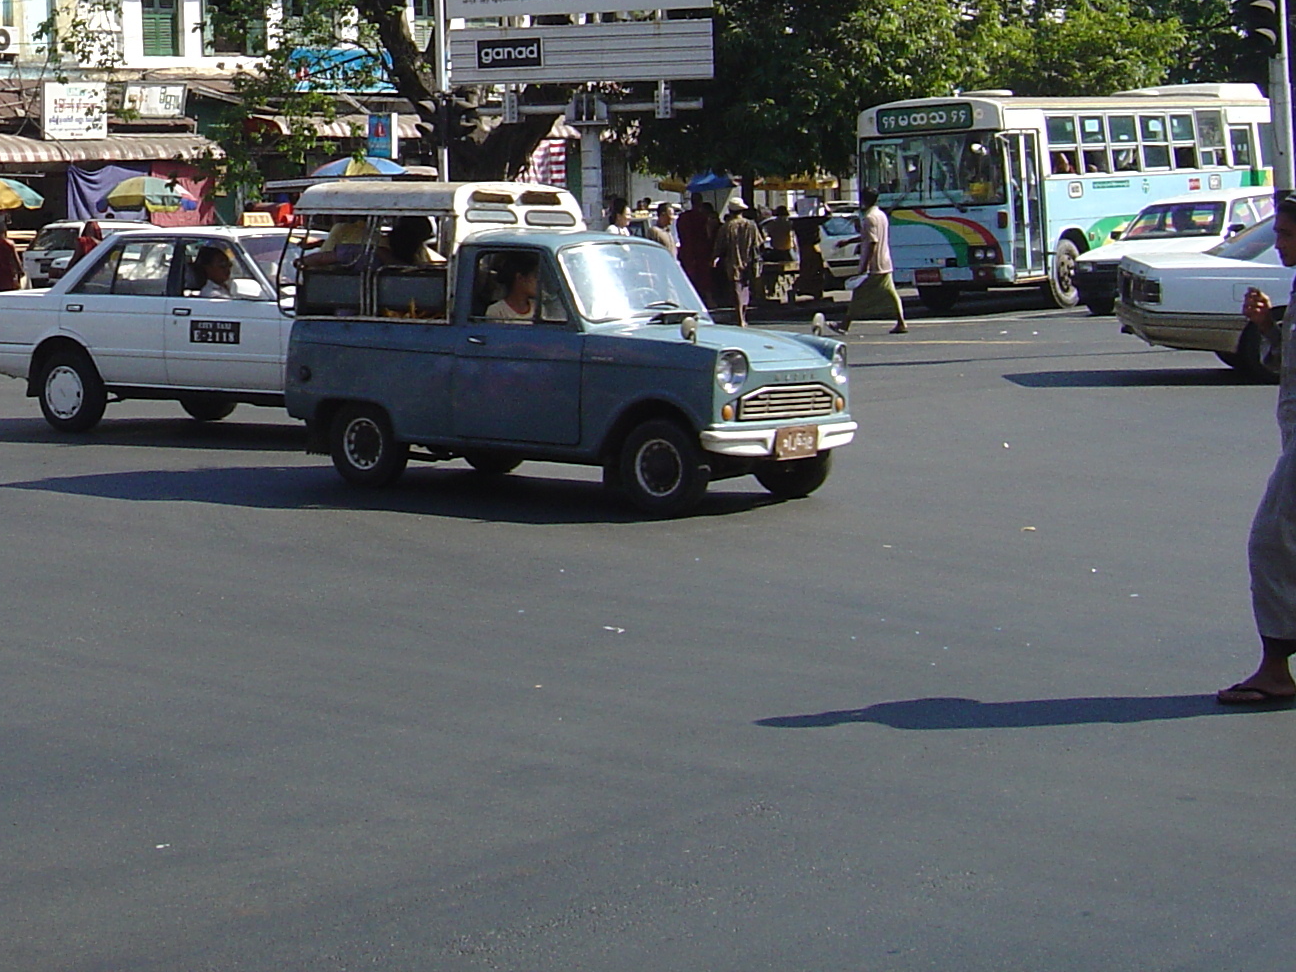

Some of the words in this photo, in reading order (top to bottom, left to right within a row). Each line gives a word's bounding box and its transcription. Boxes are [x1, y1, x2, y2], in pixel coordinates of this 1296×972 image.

[481, 42, 538, 64] ganad
[247, 215, 271, 224] TAXI
[193, 330, 235, 342] E-2118
